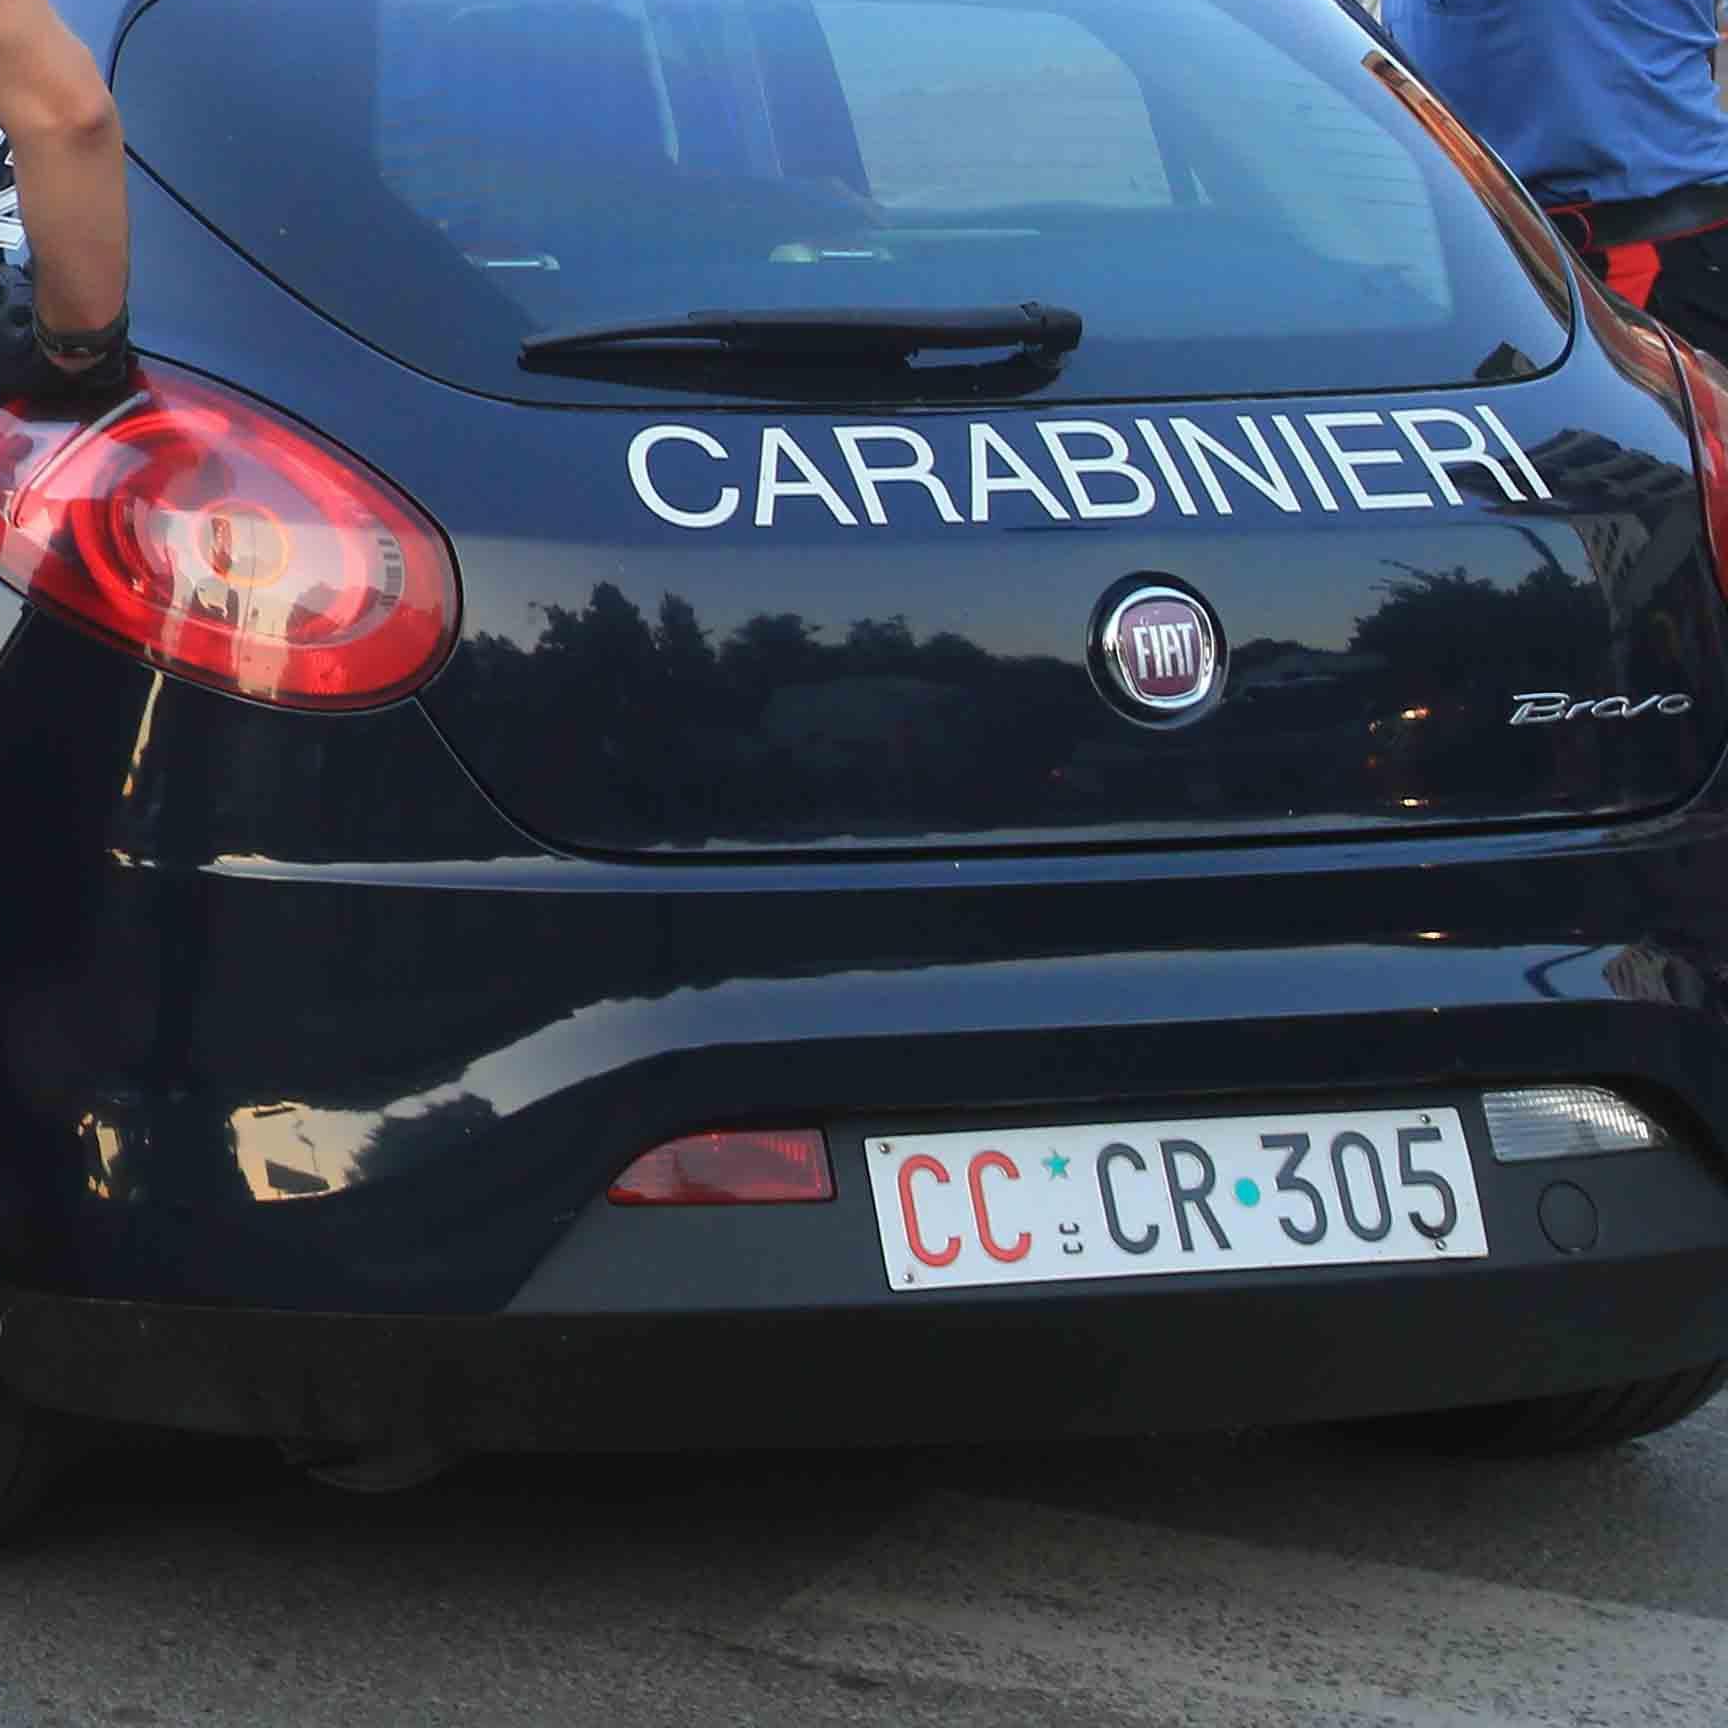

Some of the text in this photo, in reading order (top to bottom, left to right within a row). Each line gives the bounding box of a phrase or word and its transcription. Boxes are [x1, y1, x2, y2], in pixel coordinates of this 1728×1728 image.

[627, 404, 1553, 529] CARABINIERI
[1132, 621, 1196, 680] FIAT
[1509, 692, 1692, 726] Bravo
[896, 1127, 1458, 1268] CC CR 305
